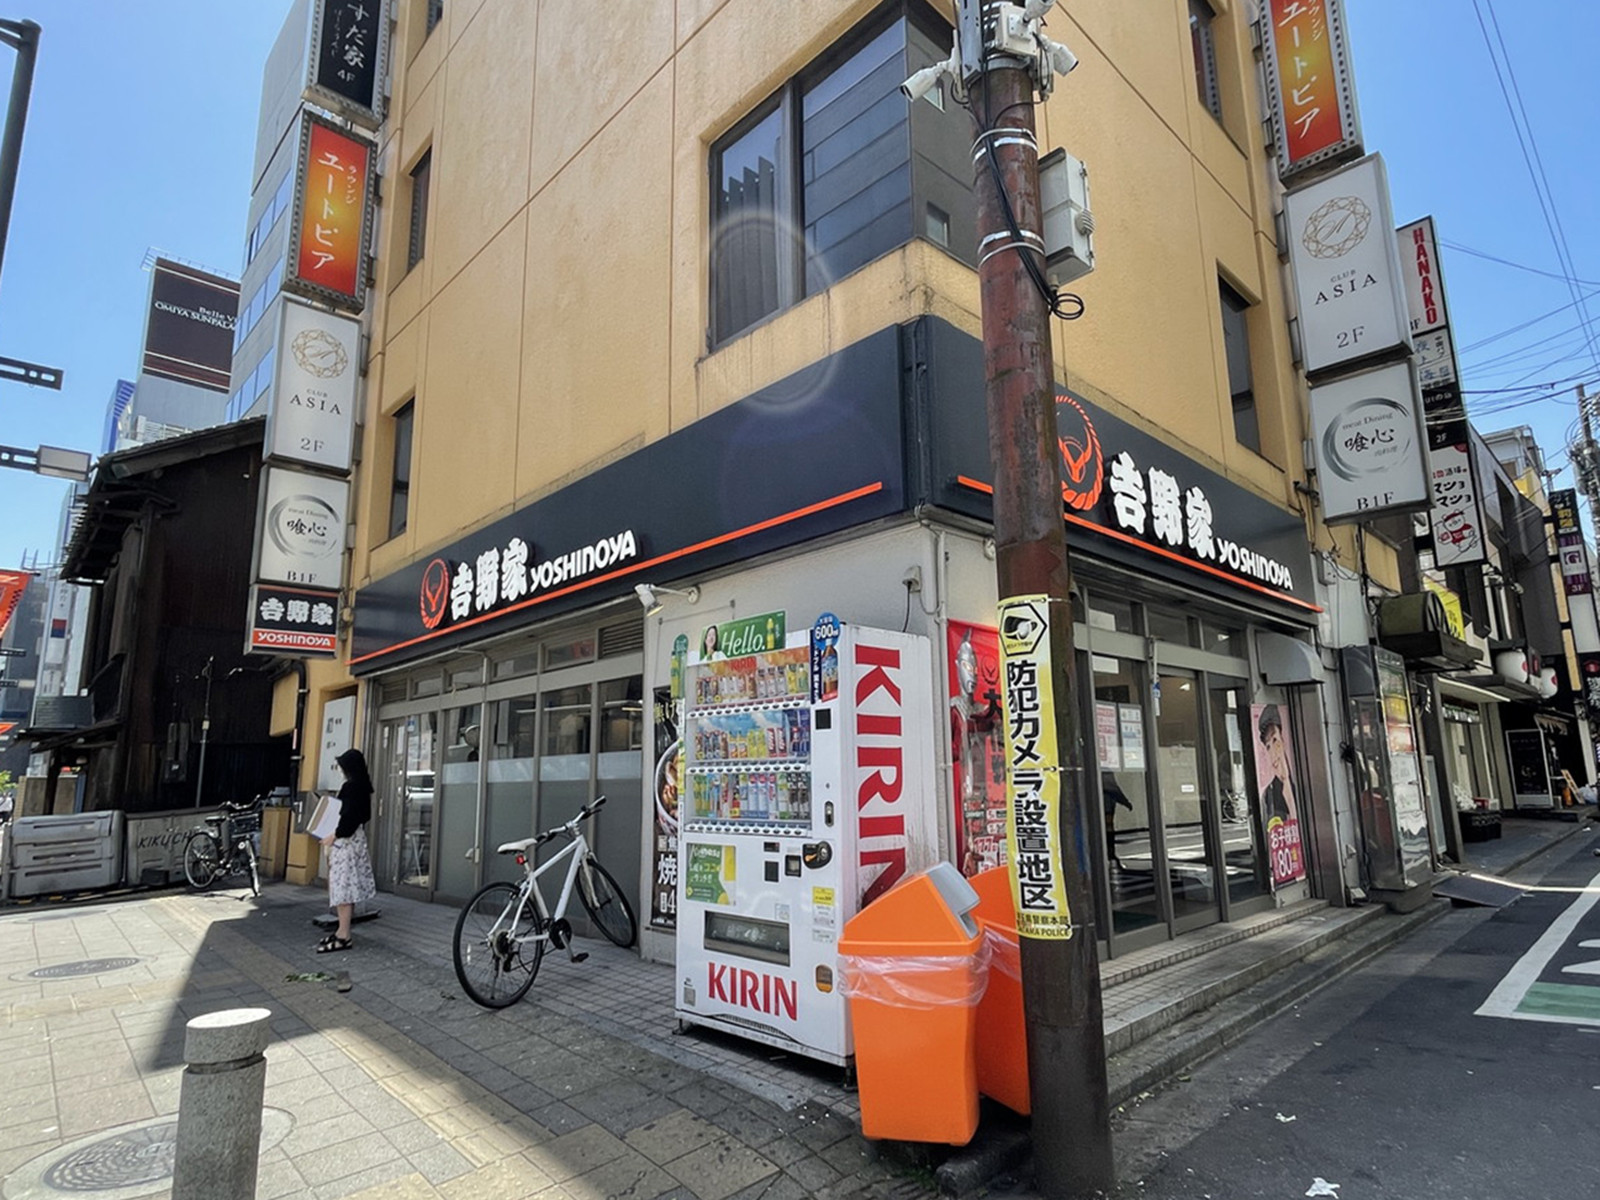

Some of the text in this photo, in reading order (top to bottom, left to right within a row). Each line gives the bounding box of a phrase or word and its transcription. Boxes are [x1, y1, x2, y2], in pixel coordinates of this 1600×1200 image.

[337, 69, 356, 82] 4F
[1278, 2, 1320, 139] ユートピア
[311, 151, 344, 269] ユートピア
[1330, 269, 1356, 283] CLUB
[1412, 227, 1438, 325] HANAKO
[1314, 273, 1377, 305] ASIA
[154, 301, 189, 318] OMIYA
[198, 307, 225, 318] Belle
[1336, 326, 1365, 349] 2F
[306, 388, 328, 398] CLUB
[290, 394, 342, 415] ASIA
[1364, 411, 1394, 426] Dining
[300, 438, 324, 453] 2F
[1436, 432, 1447, 443] 2F
[1356, 491, 1394, 511] B1F
[529, 529, 637, 593] YOSHINOYA
[1216, 537, 1294, 591] YOSHINOYA
[287, 570, 317, 583] B1F
[257, 632, 331, 647] YOSHINOYA
[720, 624, 766, 656] Hello.
[1006, 660, 1055, 910] 防犯カメラ設置地区
[1042, 928, 1069, 937] POLICE
[708, 962, 798, 1021] KIRIN
